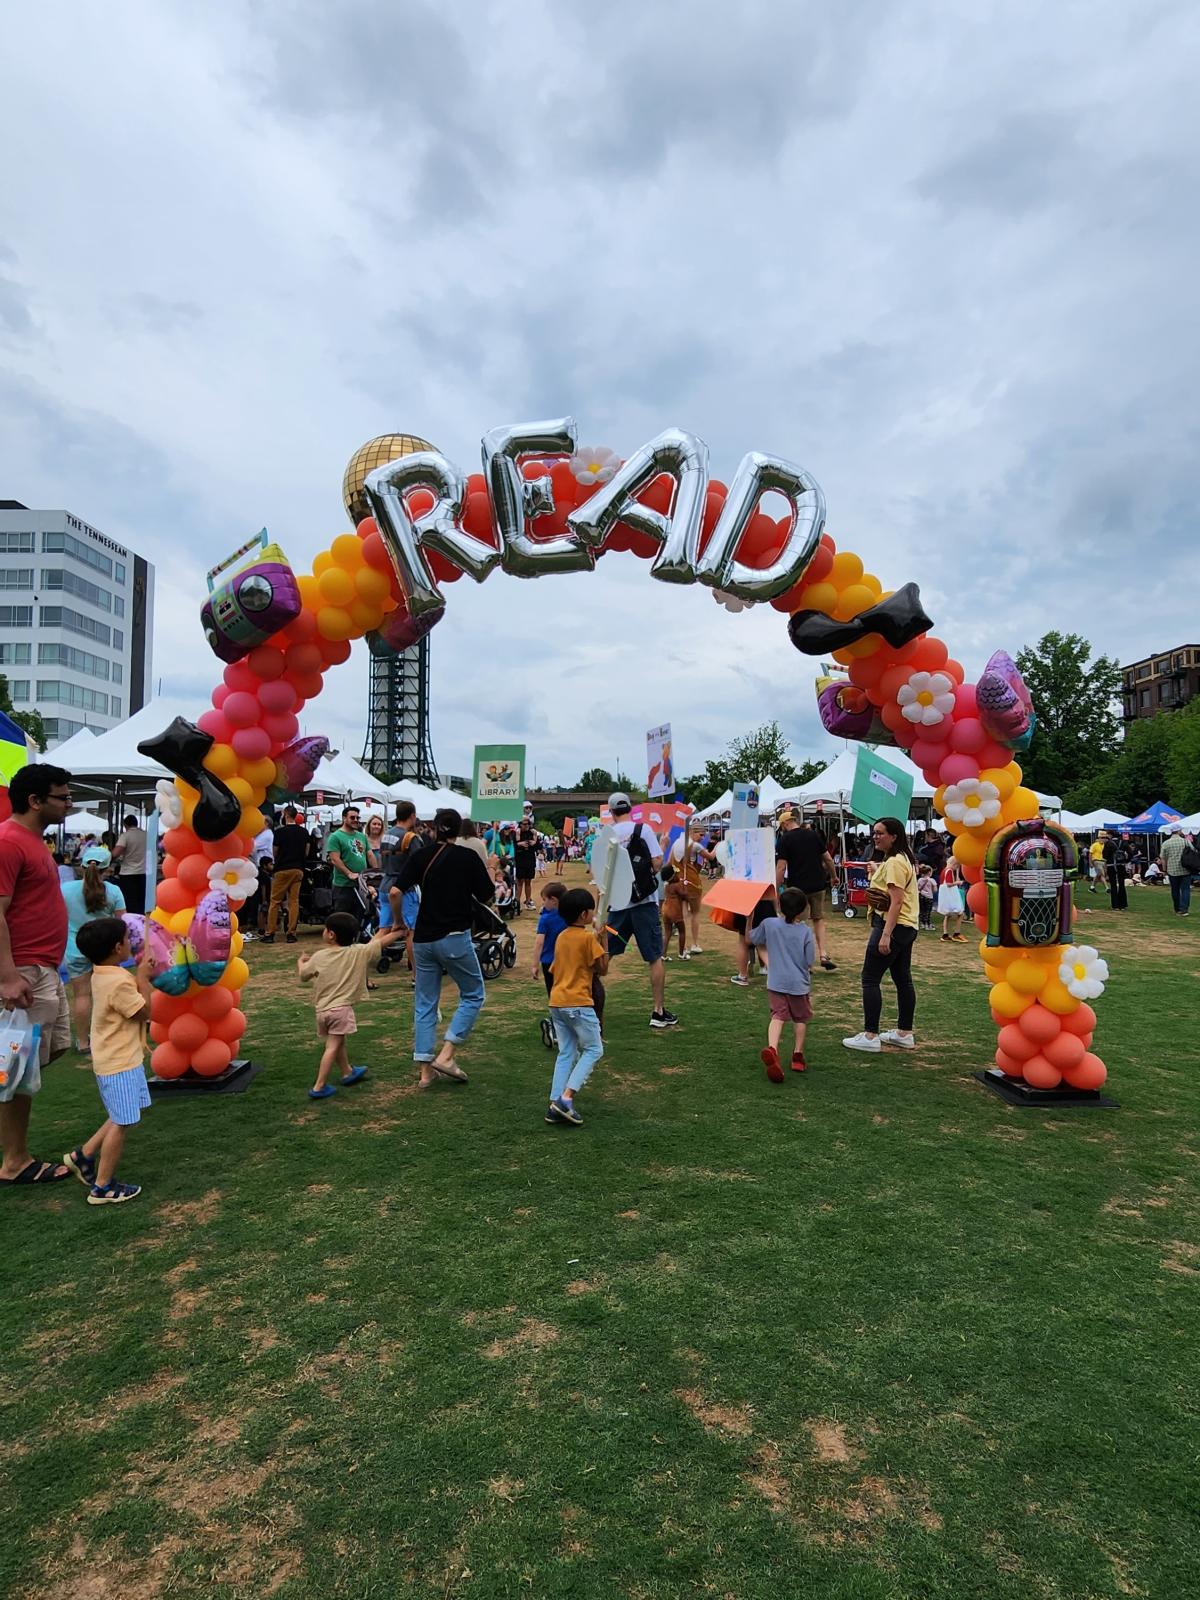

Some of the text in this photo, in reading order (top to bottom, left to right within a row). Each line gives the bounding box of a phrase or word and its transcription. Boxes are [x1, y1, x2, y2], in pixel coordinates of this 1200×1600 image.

[66, 514, 127, 558] THE TENNESSEAN
[364, 416, 826, 617] READ
[479, 788, 517, 796] LIBRARY
